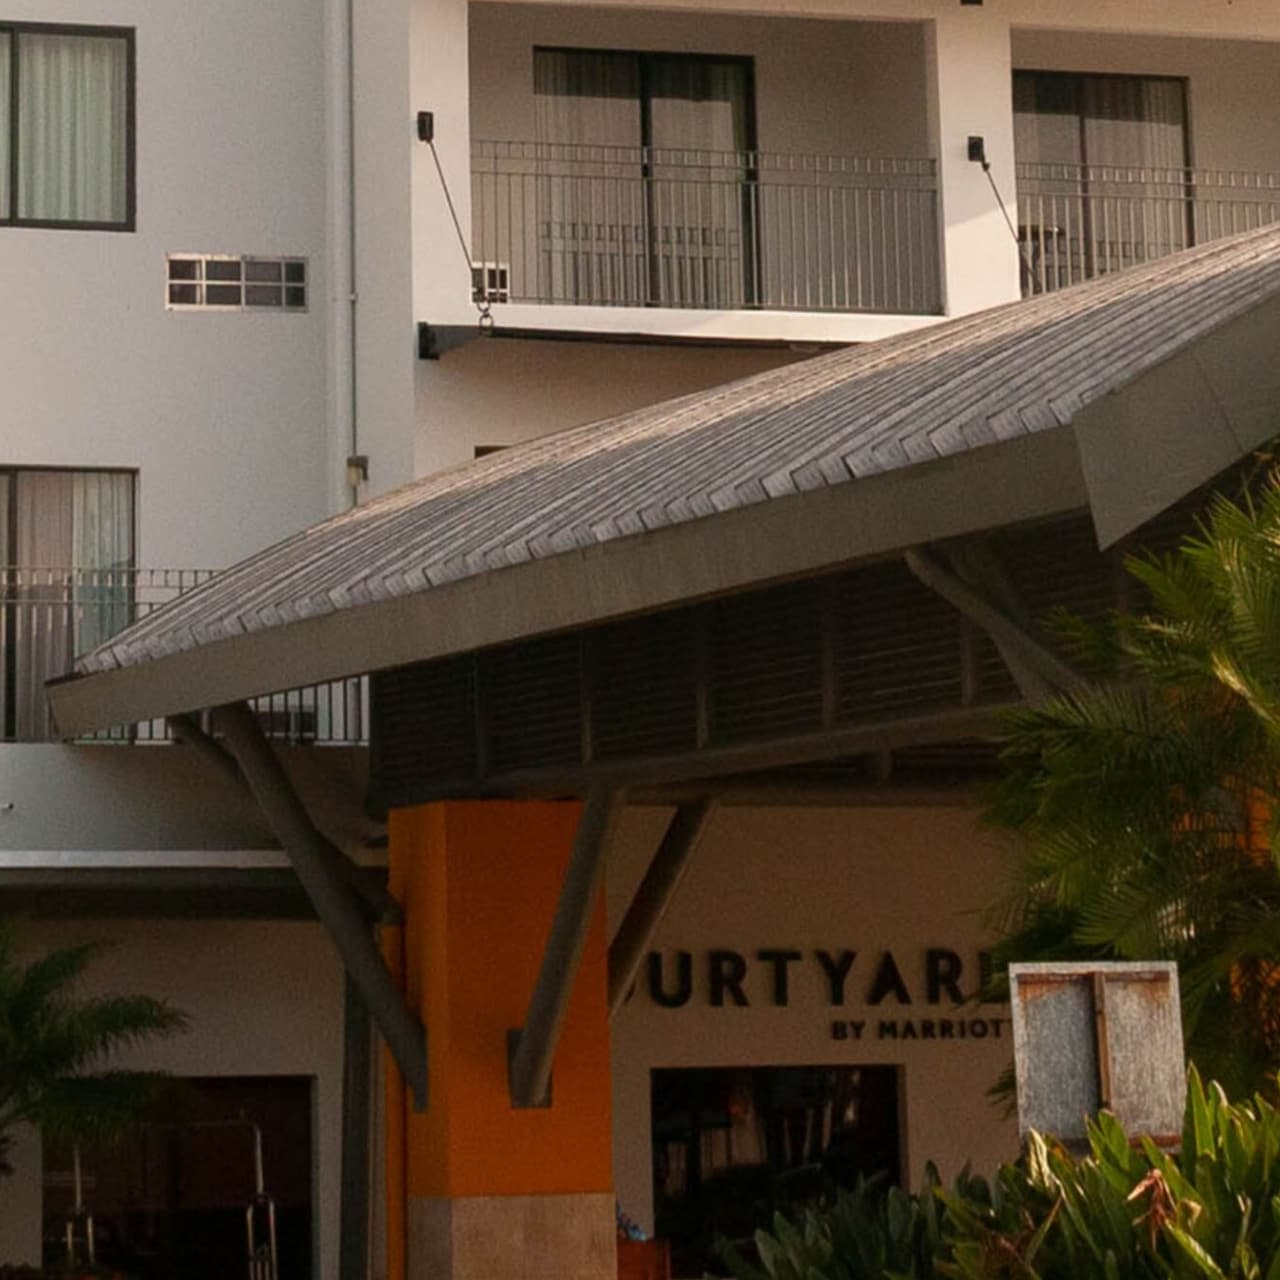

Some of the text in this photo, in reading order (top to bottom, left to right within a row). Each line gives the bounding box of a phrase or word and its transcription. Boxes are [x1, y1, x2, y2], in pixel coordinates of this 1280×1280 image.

[623, 948, 1011, 1007] URTYAR
[831, 1017, 1013, 1040] BY MARRIOT
